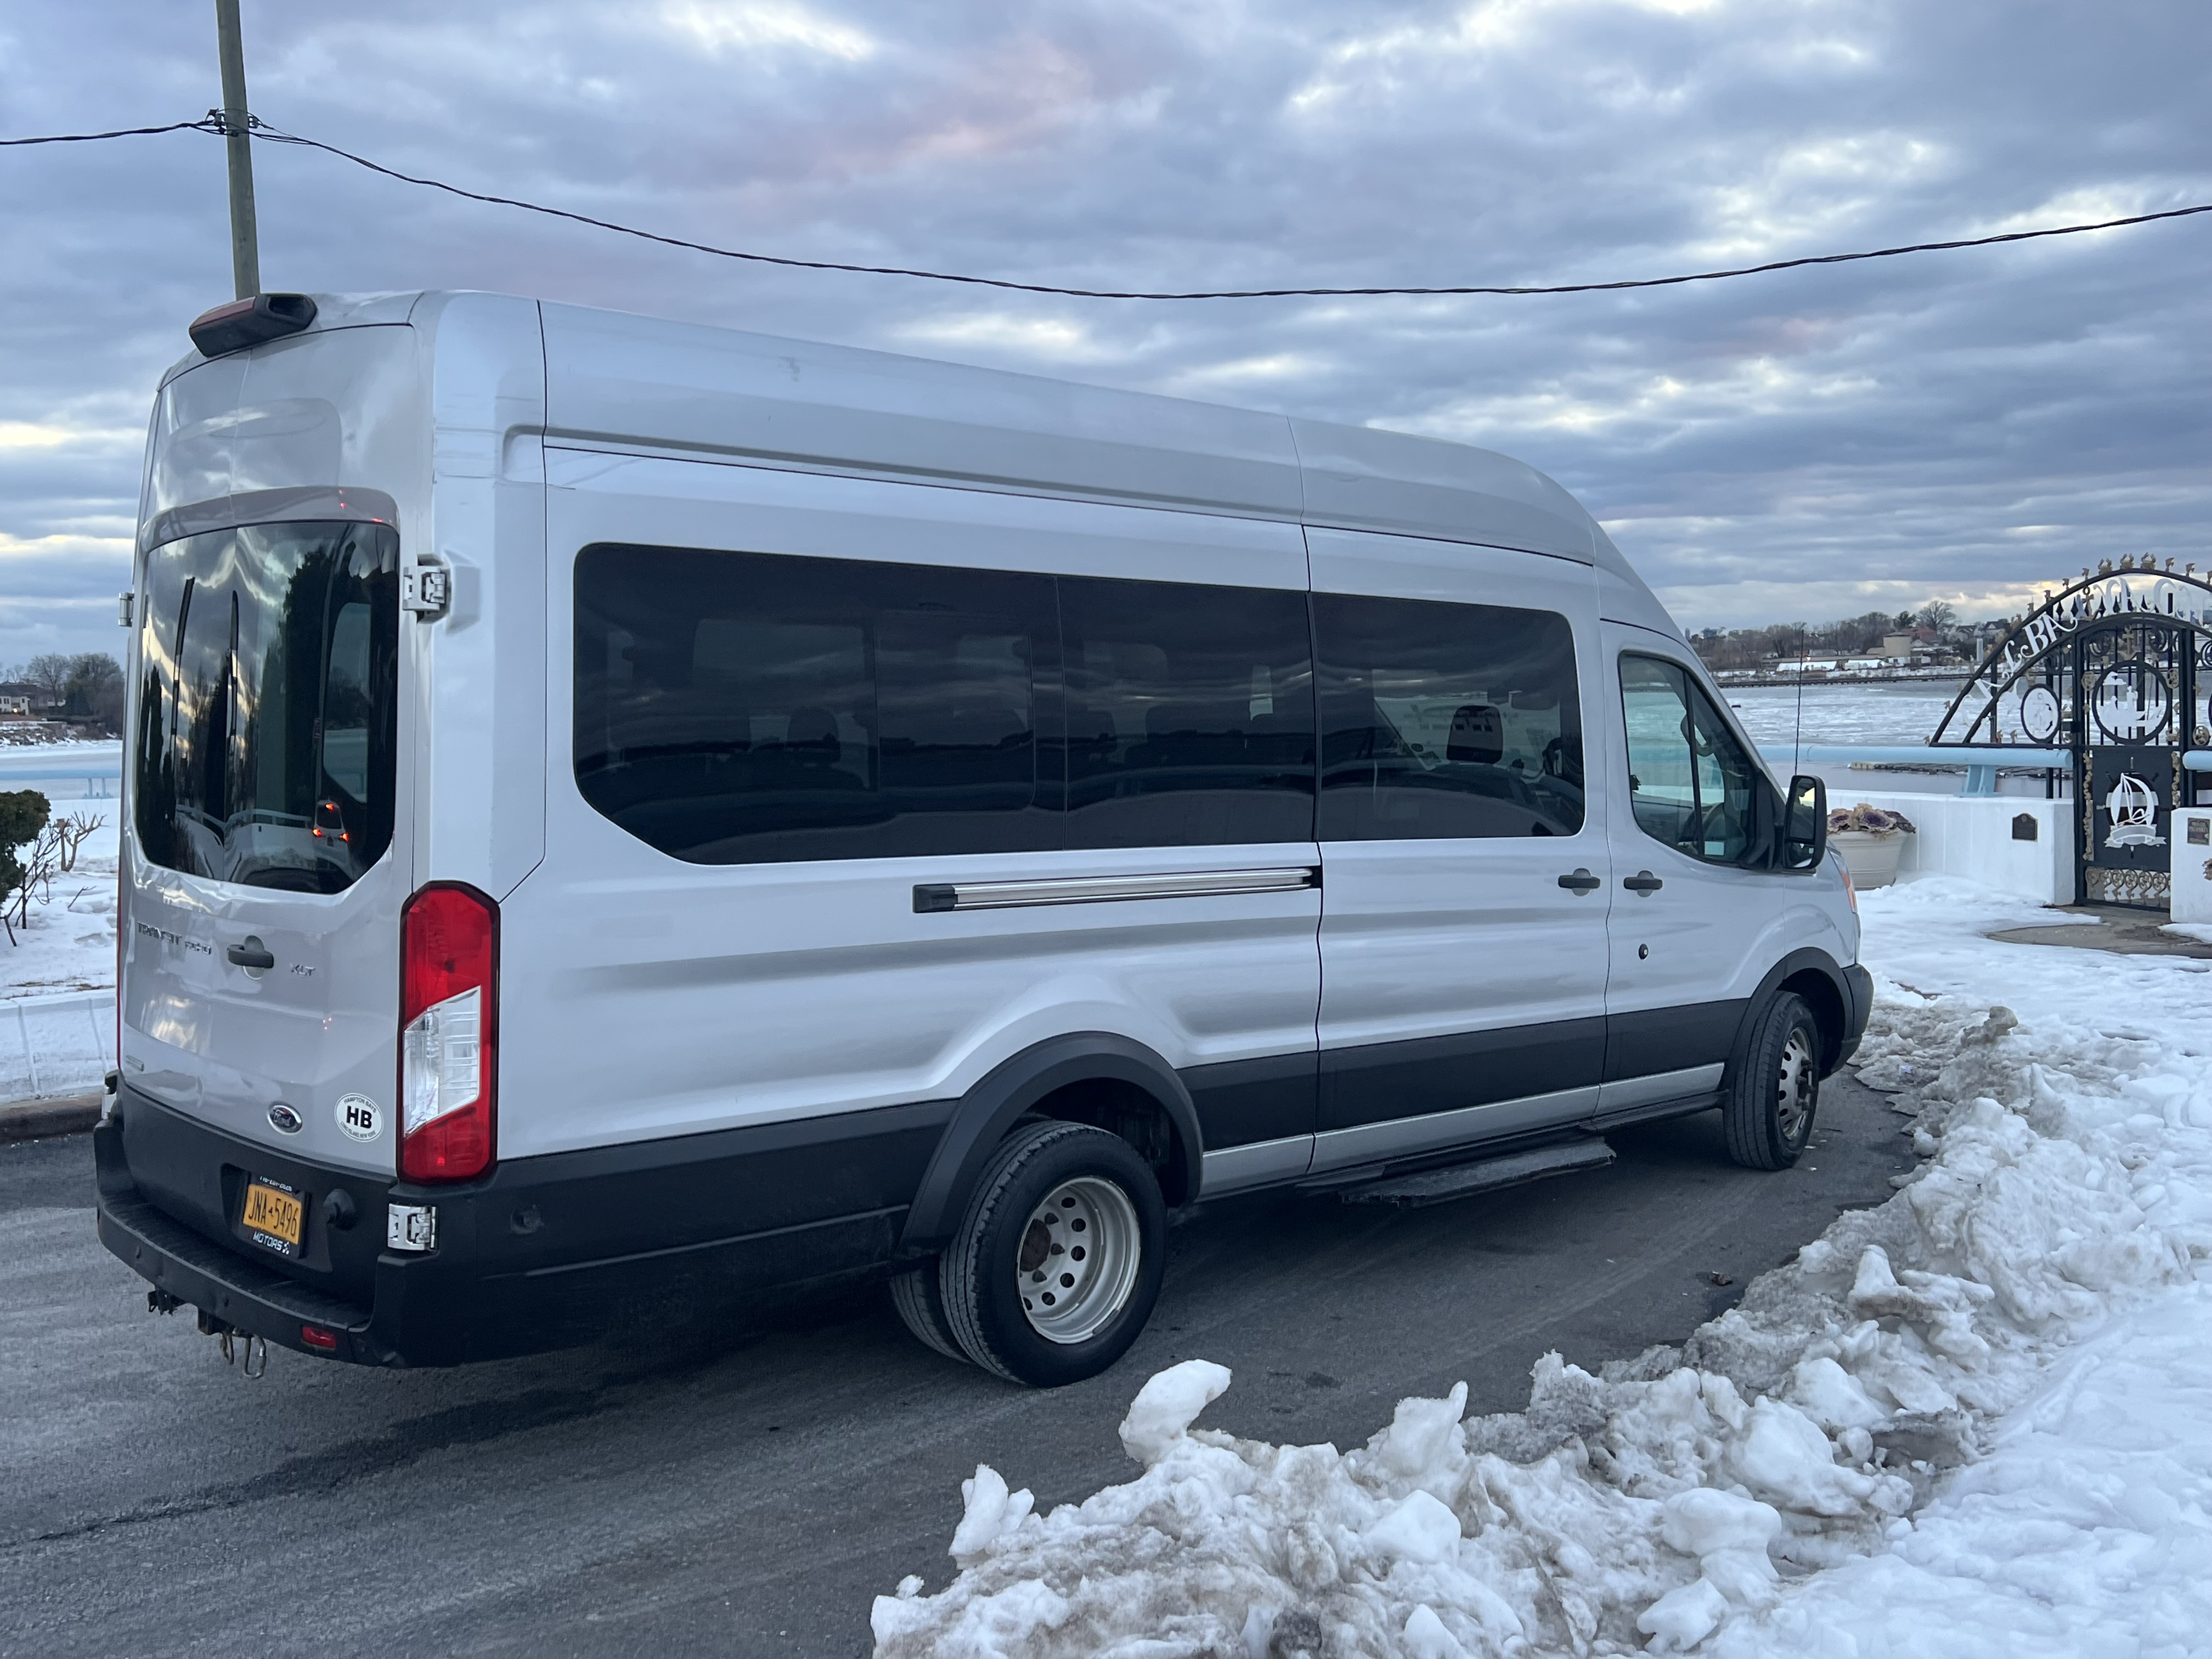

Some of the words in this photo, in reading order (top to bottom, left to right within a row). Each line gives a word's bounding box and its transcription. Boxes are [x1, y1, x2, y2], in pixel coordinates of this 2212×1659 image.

[137, 922, 182, 945] TRANSIT
[346, 1105, 372, 1129] HB
[365, 1101, 377, 1113] BAYS
[274, 1109, 292, 1126] Ford
[252, 1231, 283, 1251] MOTORS
